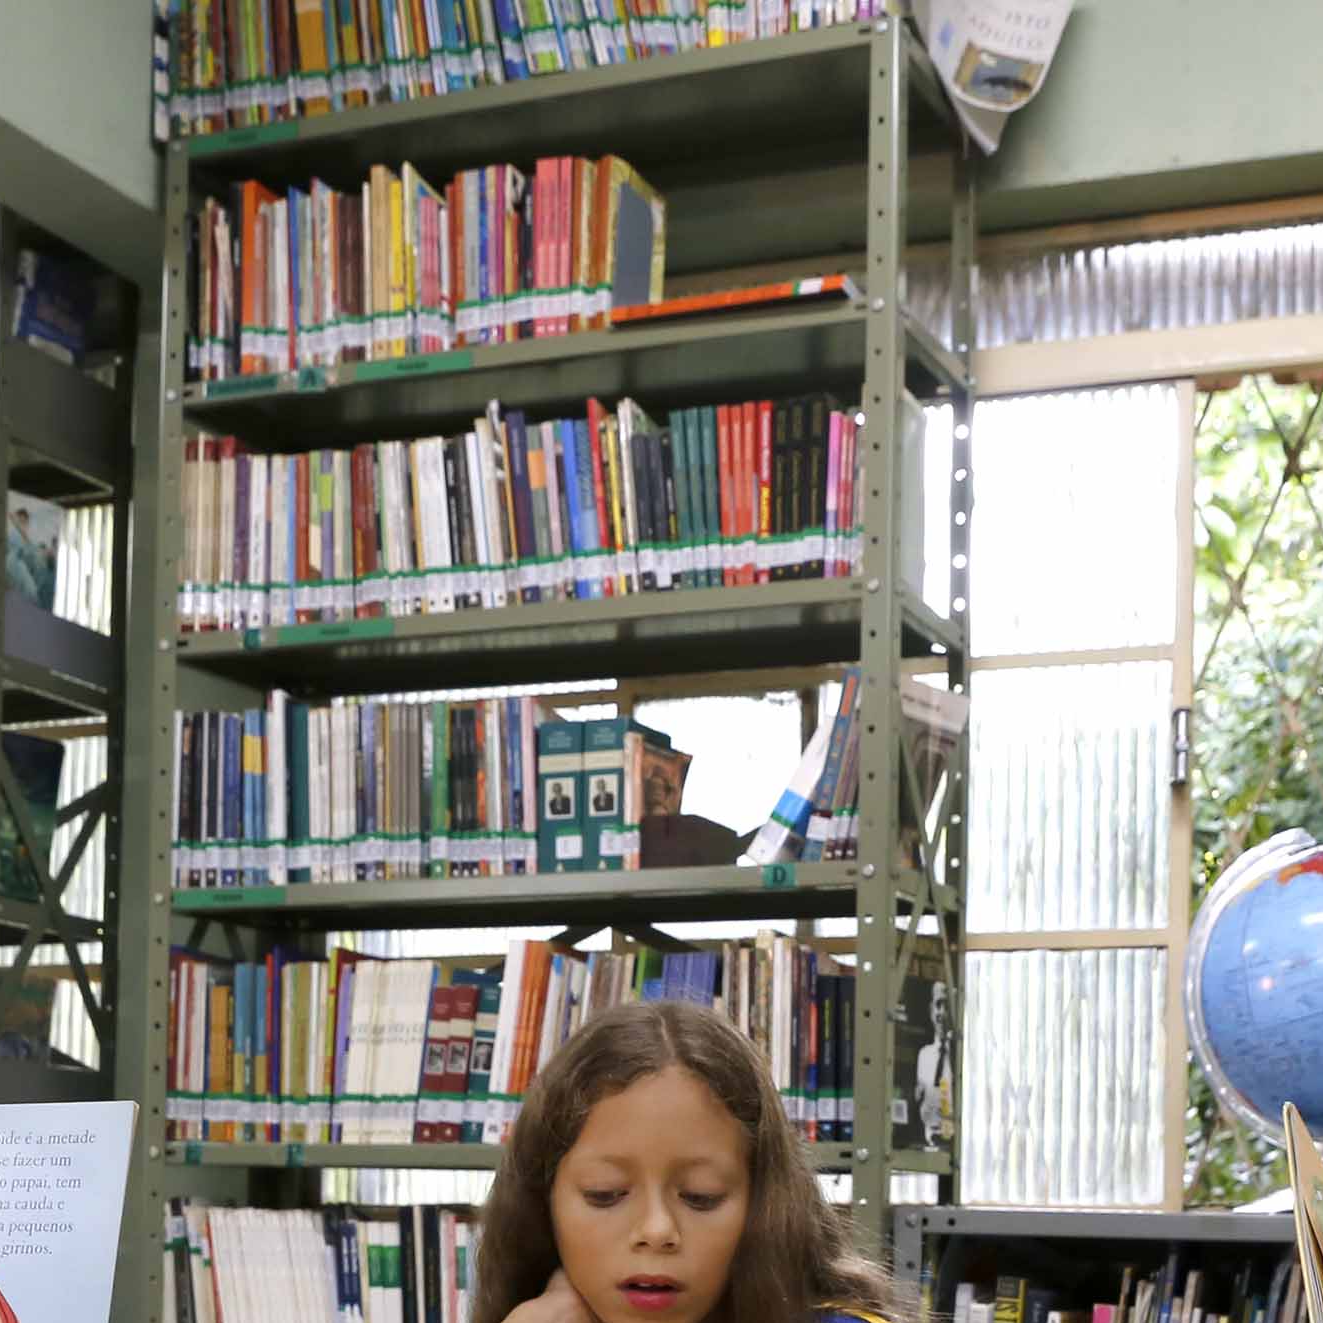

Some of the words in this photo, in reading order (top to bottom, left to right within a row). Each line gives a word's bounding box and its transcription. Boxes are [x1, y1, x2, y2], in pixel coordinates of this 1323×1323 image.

[772, 865, 787, 883] D
[24, 1131, 34, 1145] é
[36, 1135, 44, 1145] a
[48, 1129, 96, 1145] metade
[12, 1152, 47, 1168] fazer
[50, 1155, 72, 1168] um
[11, 1175, 52, 1193] papai,
[55, 1177, 82, 1190] tem
[14, 1197, 53, 1211] cauda
[57, 1201, 65, 1211] e
[8, 1222, 74, 1239] pequenos
[0, 1241, 53, 1258] girinos.
